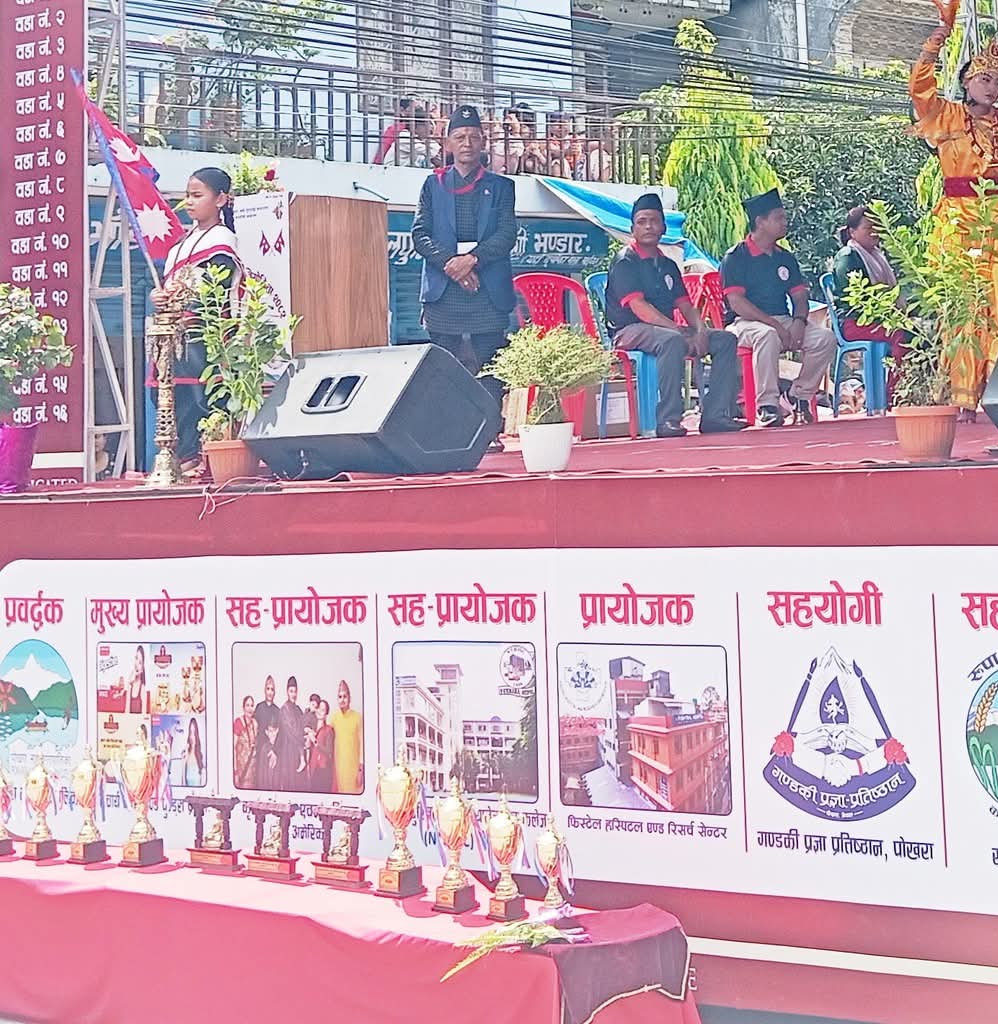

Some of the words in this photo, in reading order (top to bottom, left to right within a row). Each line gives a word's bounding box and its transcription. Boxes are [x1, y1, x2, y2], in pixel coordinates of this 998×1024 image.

[15, 14, 35, 33] वडा
[56, 10, 65, 26] २
[15, 42, 36, 60] वडा
[56, 37, 65, 55] ३
[15, 70, 36, 87] वडा
[56, 65, 65, 81] ४
[15, 97, 36, 115] वडा
[15, 125, 36, 142] वडा
[14, 153, 35, 170] वडा
[55, 149, 66, 165] ७
[15, 180, 36, 198] वडा
[56, 177, 65, 193] ८
[15, 208, 35, 226] वडा
[56, 205, 65, 222] ९
[10, 237, 31, 254] वडा
[51, 234, 69, 250] १०
[12, 265, 32, 282] वडा
[53, 261, 68, 278] ११
[52, 290, 68, 307] १२
[90, 597, 131, 633] मुख्य
[136, 588, 206, 628] प्रायोजक
[579, 583, 695, 628] प्रायोजक
[767, 580, 883, 627] सहयोगी
[757, 828, 800, 851] गण्डकी
[893, 835, 934, 861] पोखरा
